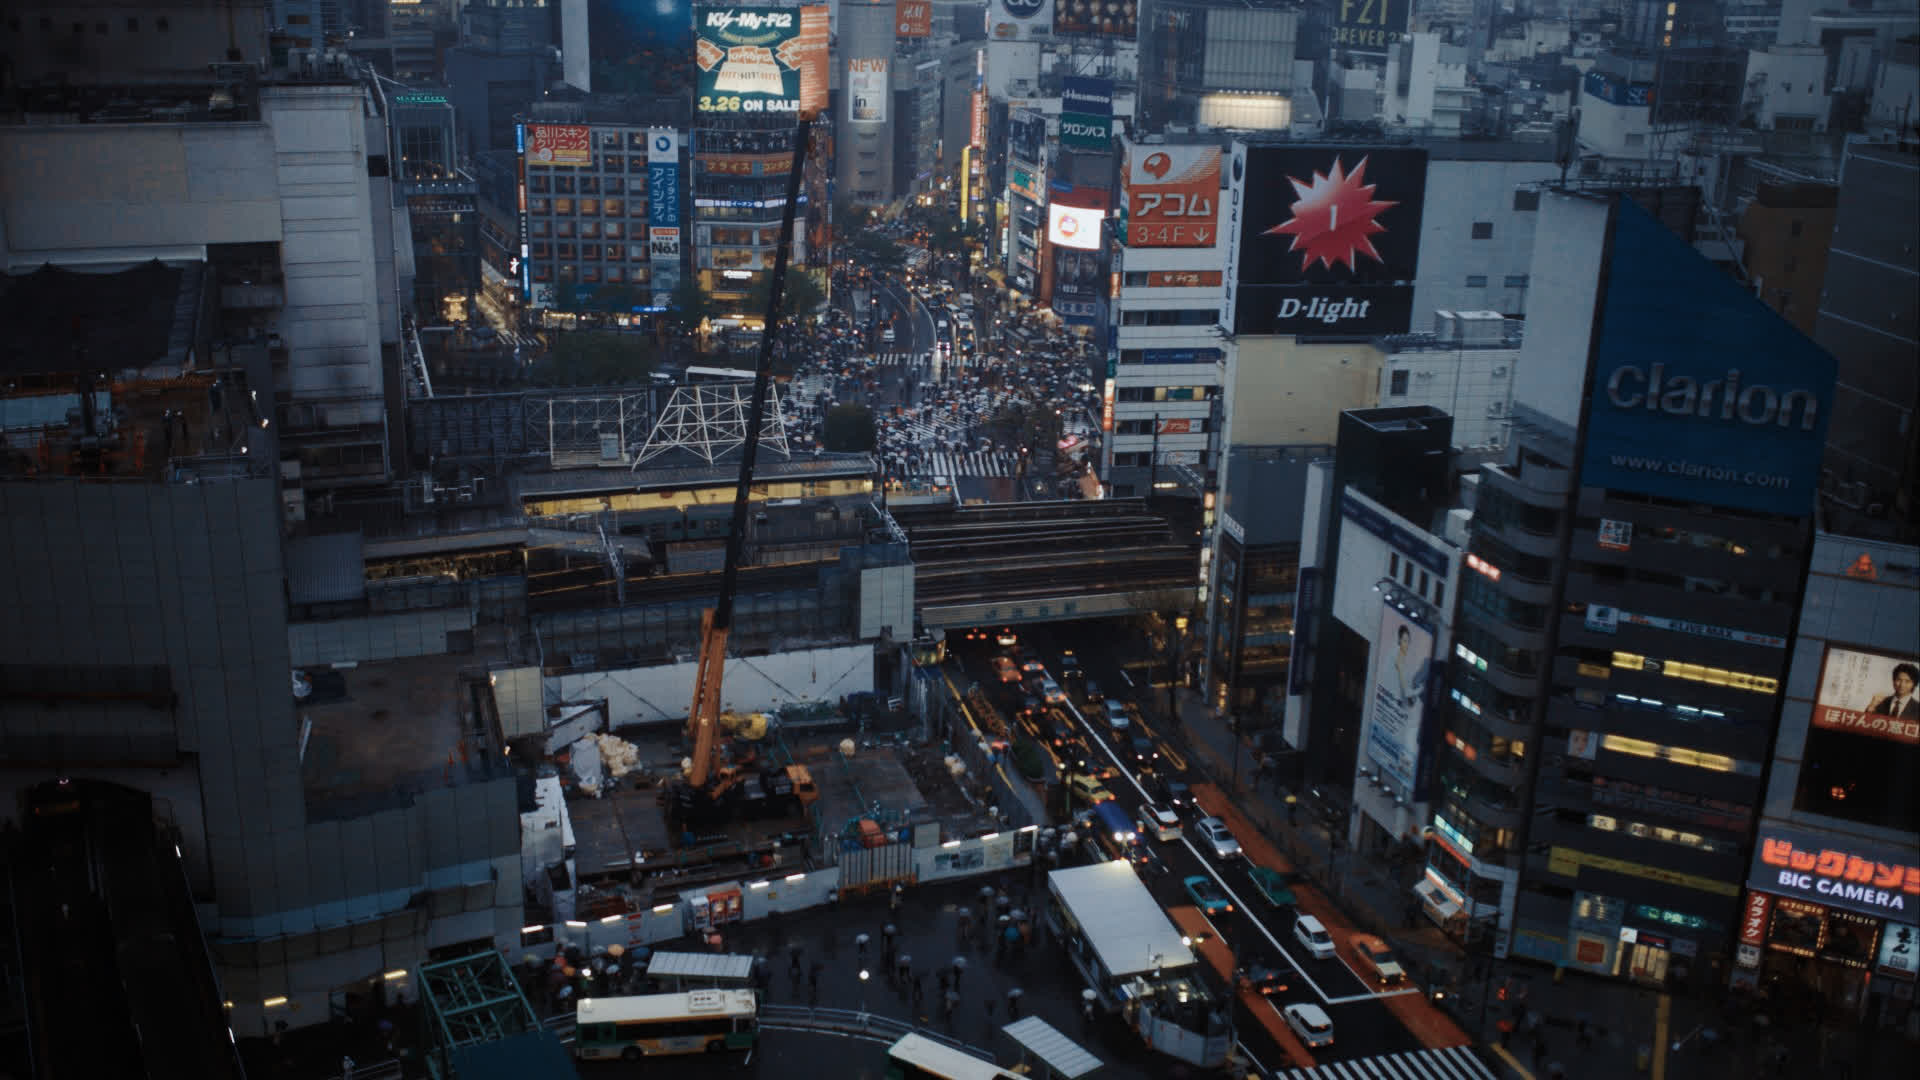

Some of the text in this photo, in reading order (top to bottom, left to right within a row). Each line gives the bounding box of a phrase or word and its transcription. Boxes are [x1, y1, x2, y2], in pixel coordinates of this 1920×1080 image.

[1330, 26, 1386, 48] REVER
[742, 99, 763, 112] ON
[766, 99, 801, 112] SALE
[1062, 122, 1106, 139] サロンパス
[1136, 193, 1212, 217] アコム
[1607, 362, 1817, 431] Clarion
[1610, 453, 1793, 490] www.clarion.com
[1824, 709, 1920, 738] ほけんの窓口
[1778, 869, 1905, 911] BIC CAMERA
